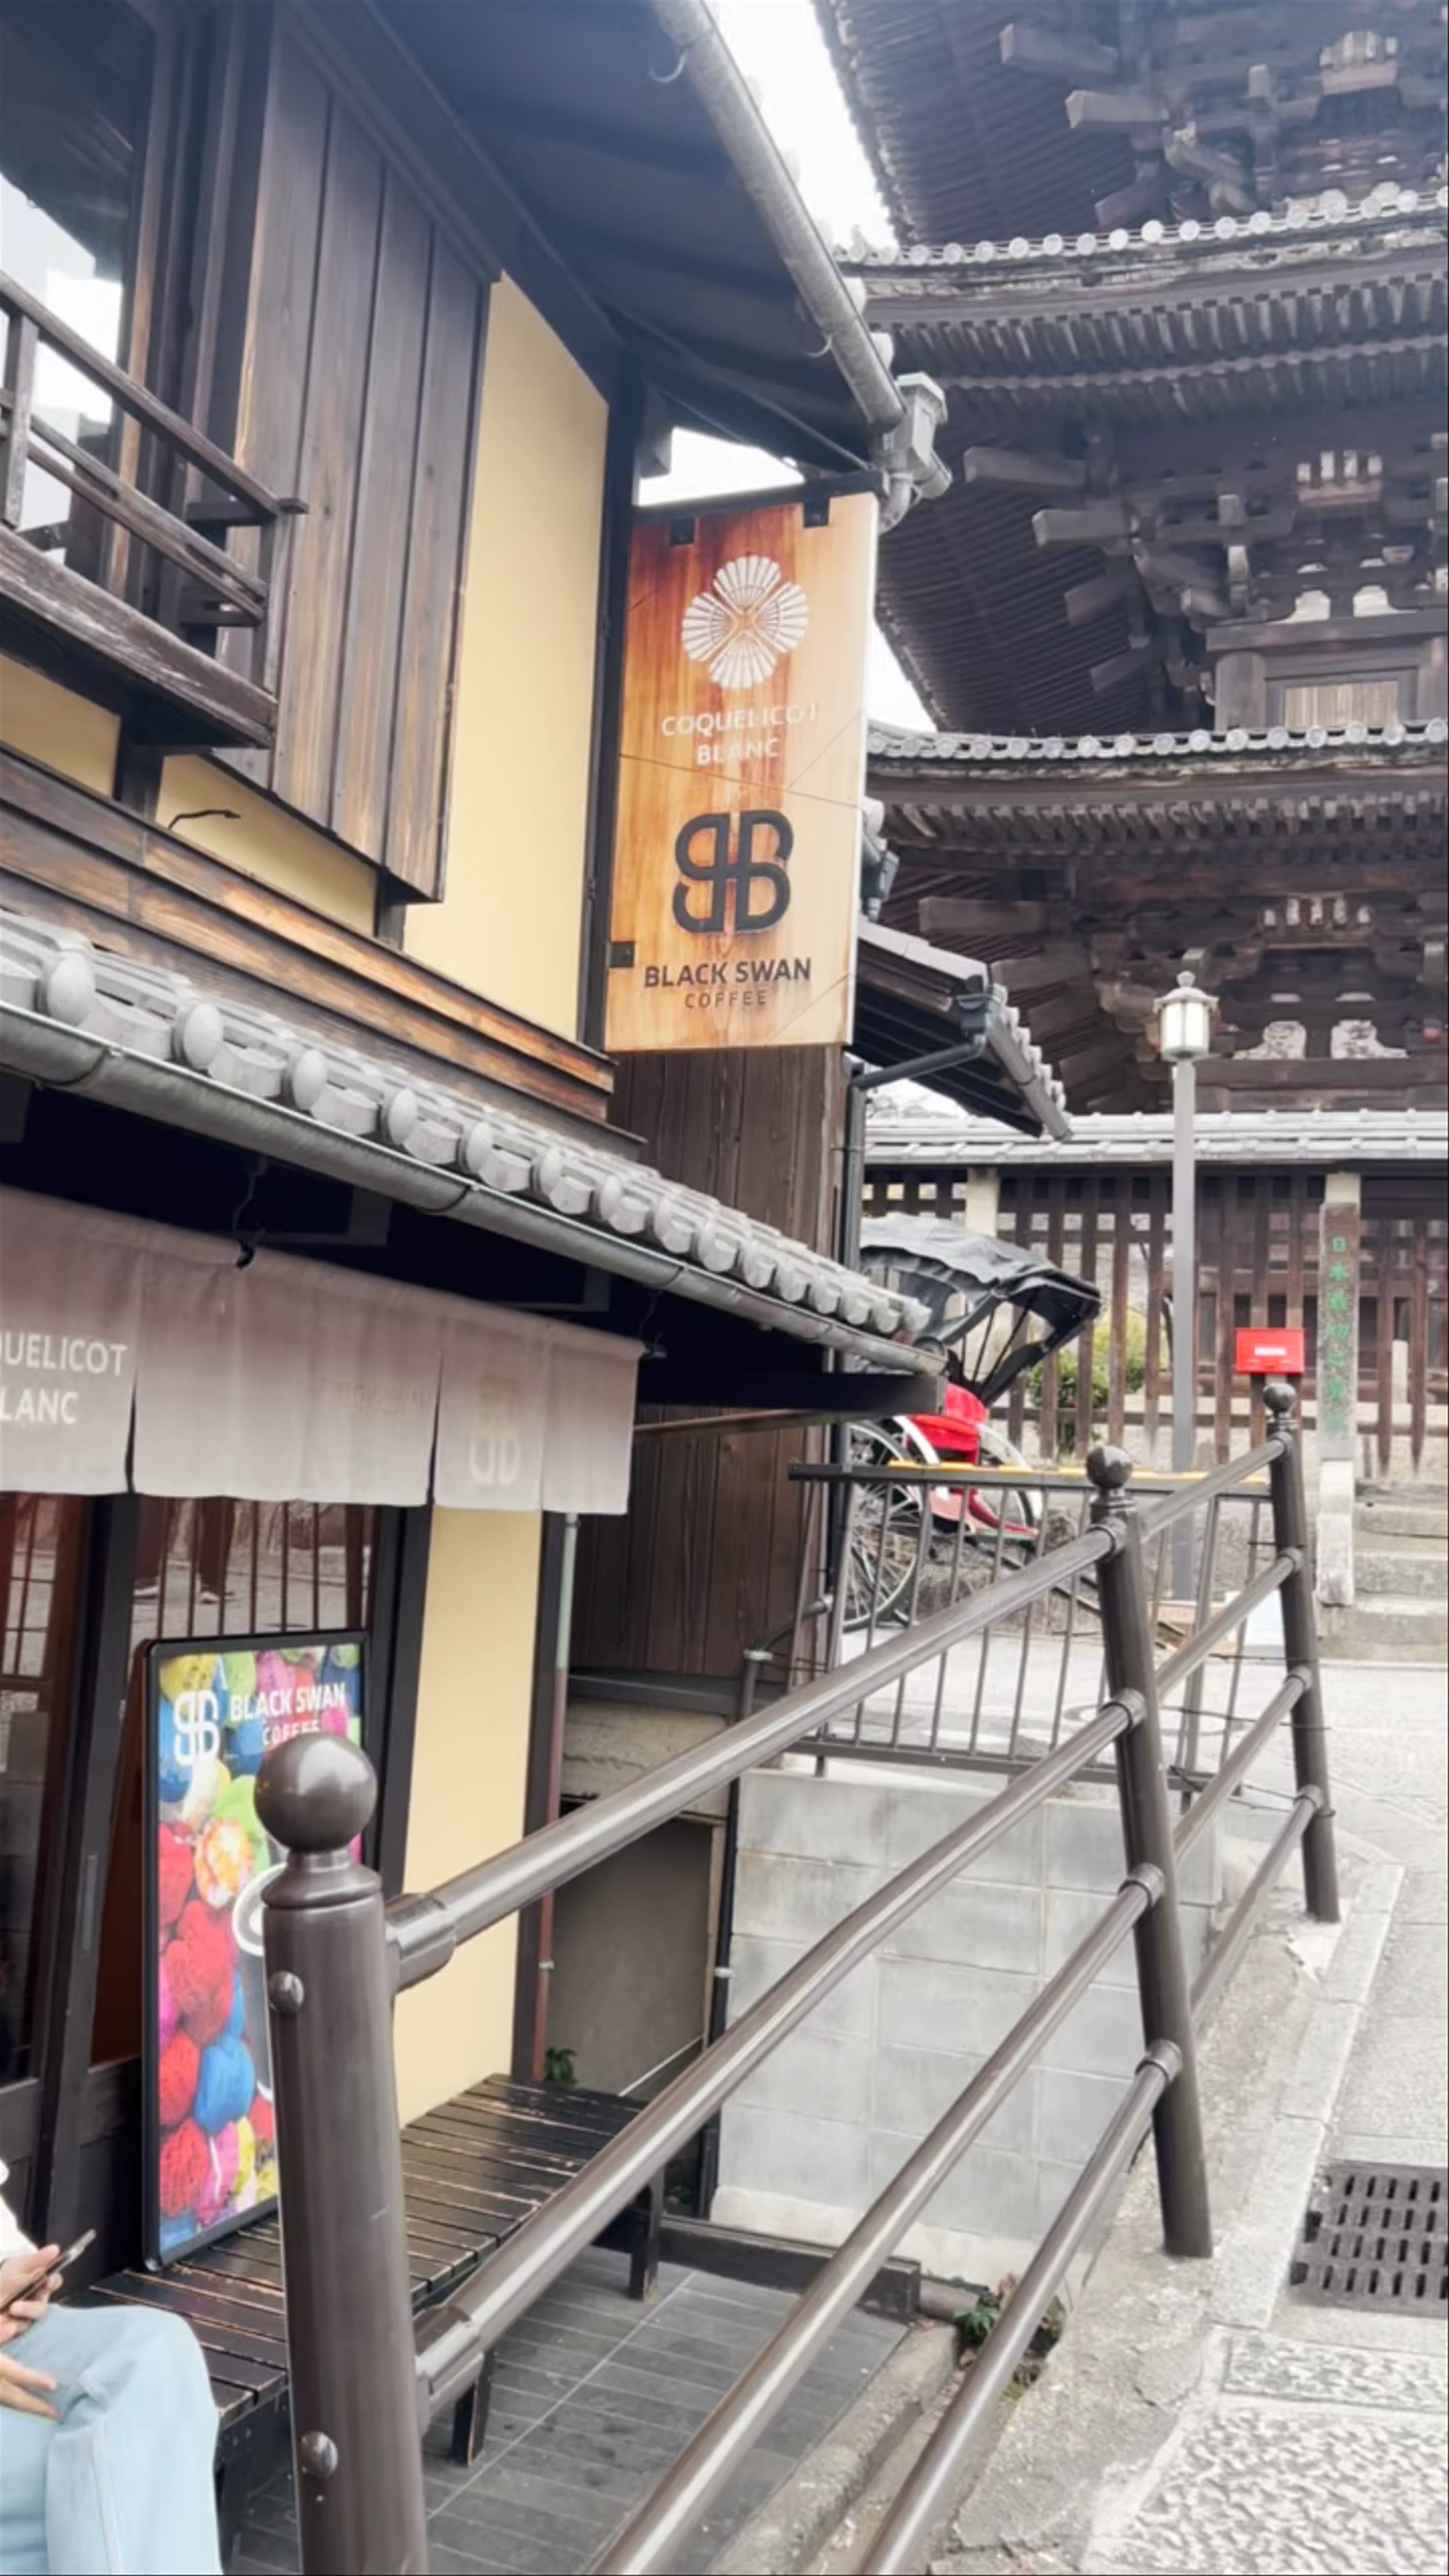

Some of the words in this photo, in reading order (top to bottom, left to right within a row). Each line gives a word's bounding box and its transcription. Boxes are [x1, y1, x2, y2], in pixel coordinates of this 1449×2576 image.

[697, 738, 780, 766] BLANC
[645, 962, 728, 987] BLACK
[735, 957, 811, 983] SWAN
[685, 989, 767, 1008] COFFEE
[0, 1330, 128, 1376] UELICOT
[230, 1689, 293, 1722] BLACK
[296, 1682, 346, 1713] SWAN
